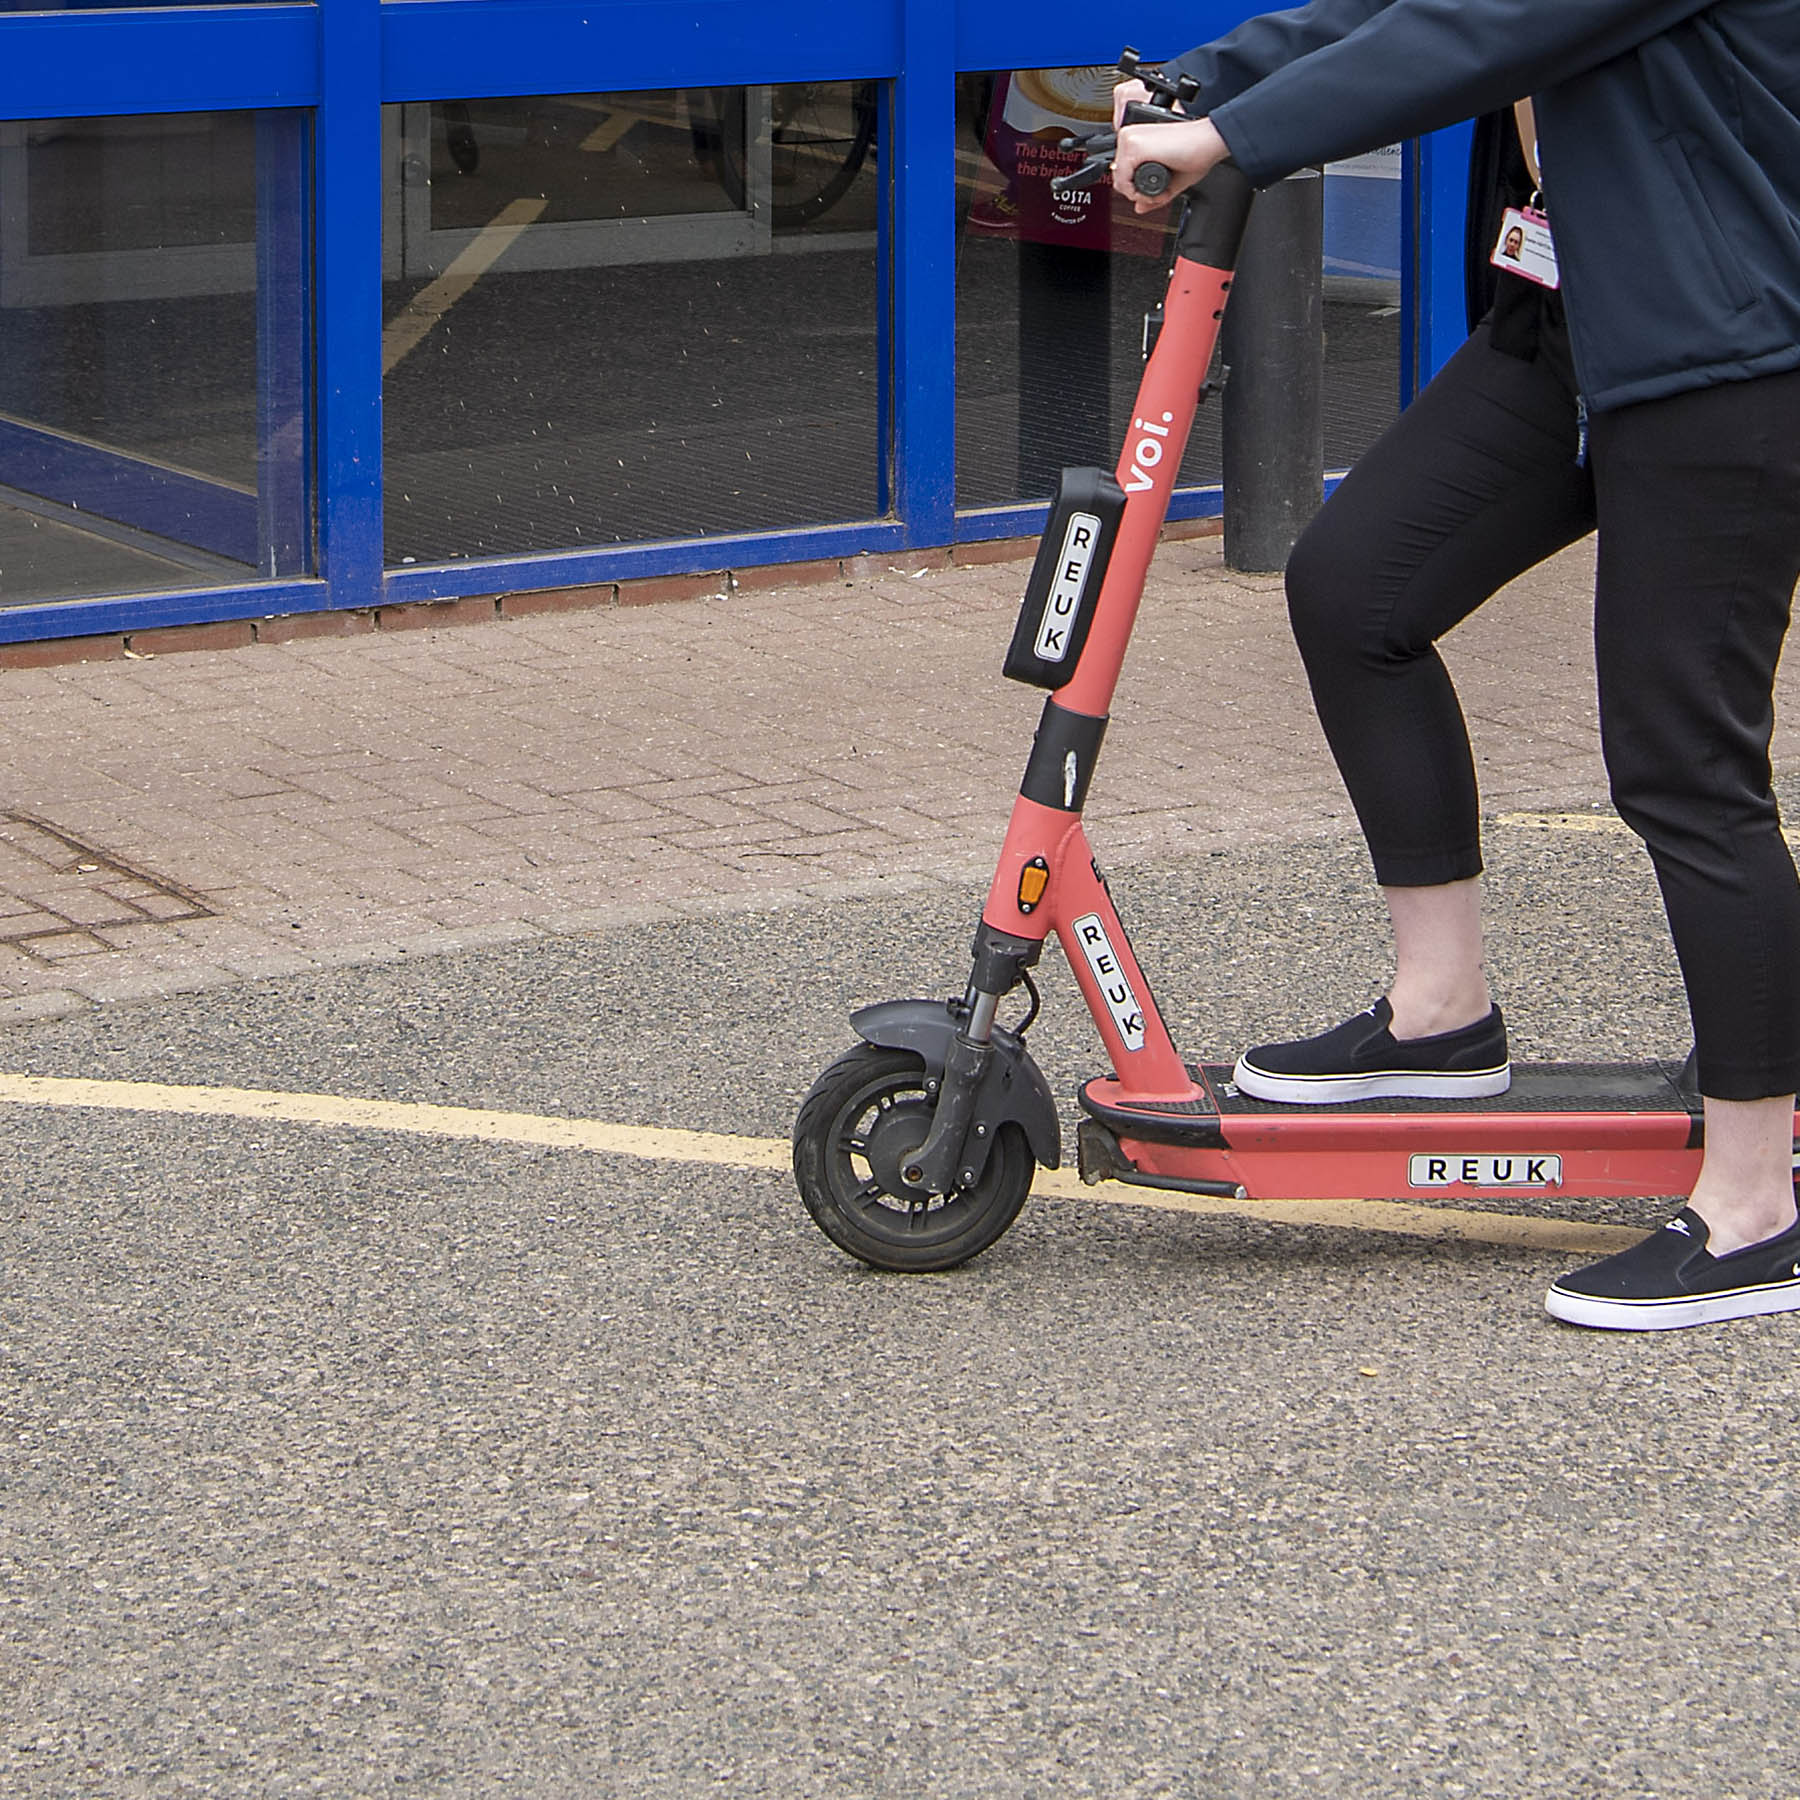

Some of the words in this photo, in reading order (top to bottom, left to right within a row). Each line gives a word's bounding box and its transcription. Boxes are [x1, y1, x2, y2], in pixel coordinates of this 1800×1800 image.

[1015, 142, 1039, 158] The
[1041, 144, 1078, 162] better
[1017, 162, 1041, 176] the
[1052, 189, 1092, 205] COSTA
[1059, 203, 1082, 213] COFFEE
[1428, 1159, 1547, 1182] REUK
